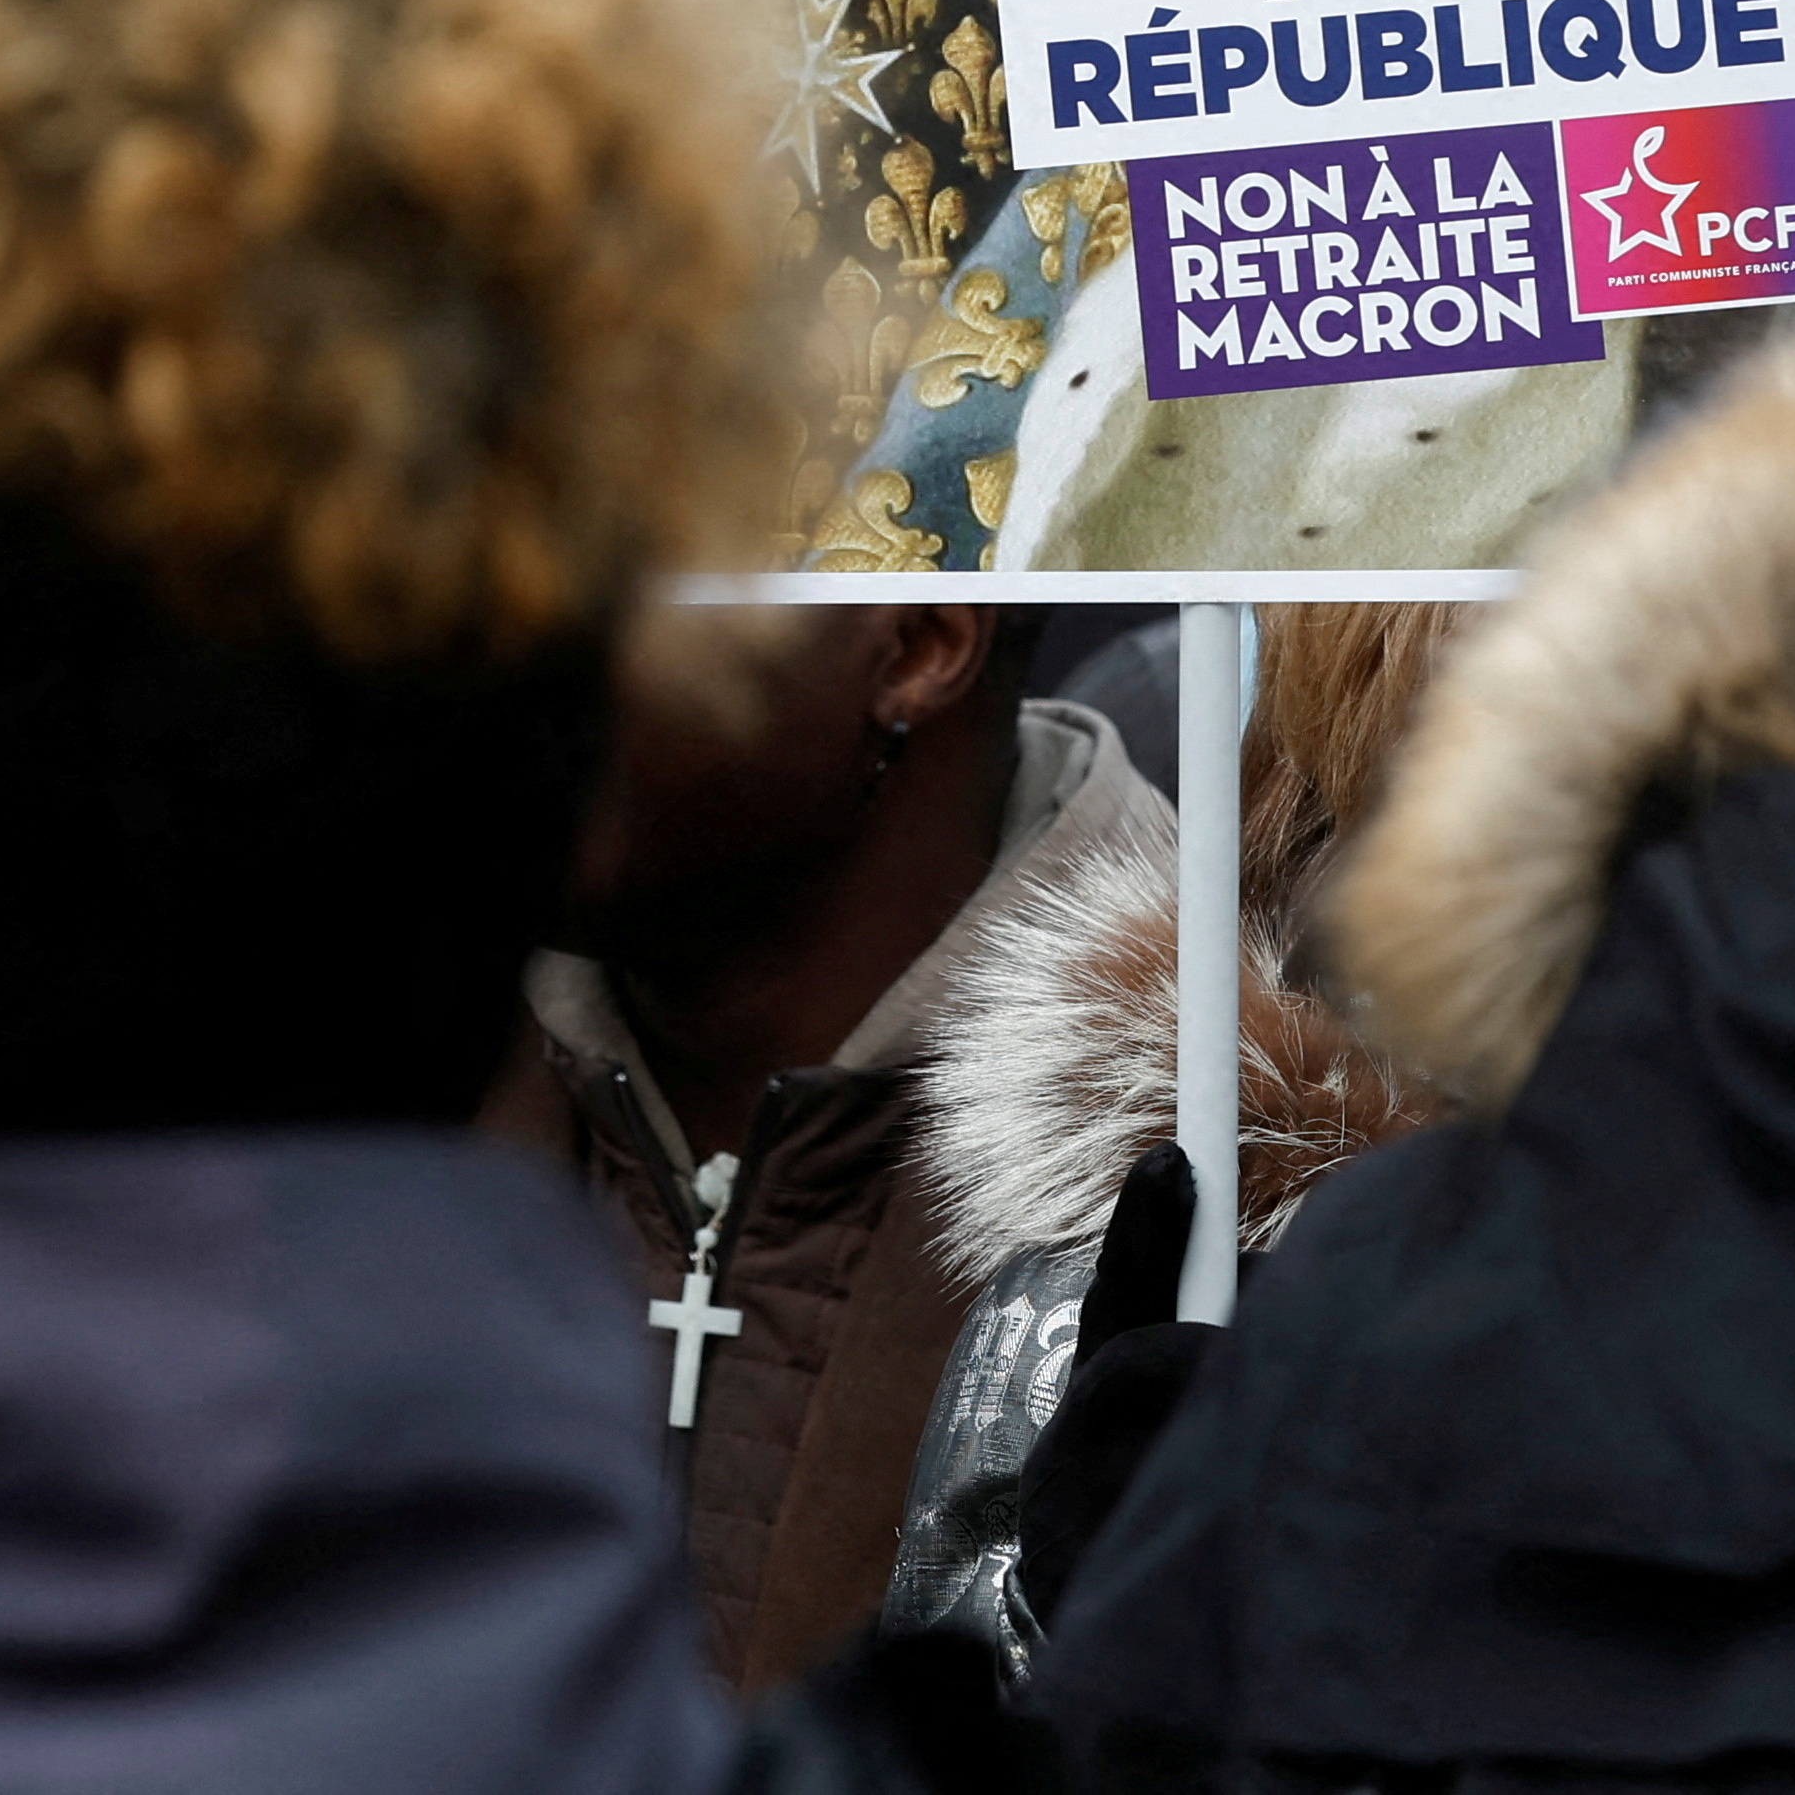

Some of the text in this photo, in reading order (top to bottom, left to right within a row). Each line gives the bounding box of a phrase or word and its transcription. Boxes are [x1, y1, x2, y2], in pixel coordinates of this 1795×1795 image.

[1164, 145, 1534, 241] NON À LA
[1171, 212, 1536, 303] RETRAITE
[1607, 274, 1645, 287] PARTI
[1649, 266, 1741, 284] COMMUNISTE
[1177, 277, 1541, 372] MACRON
